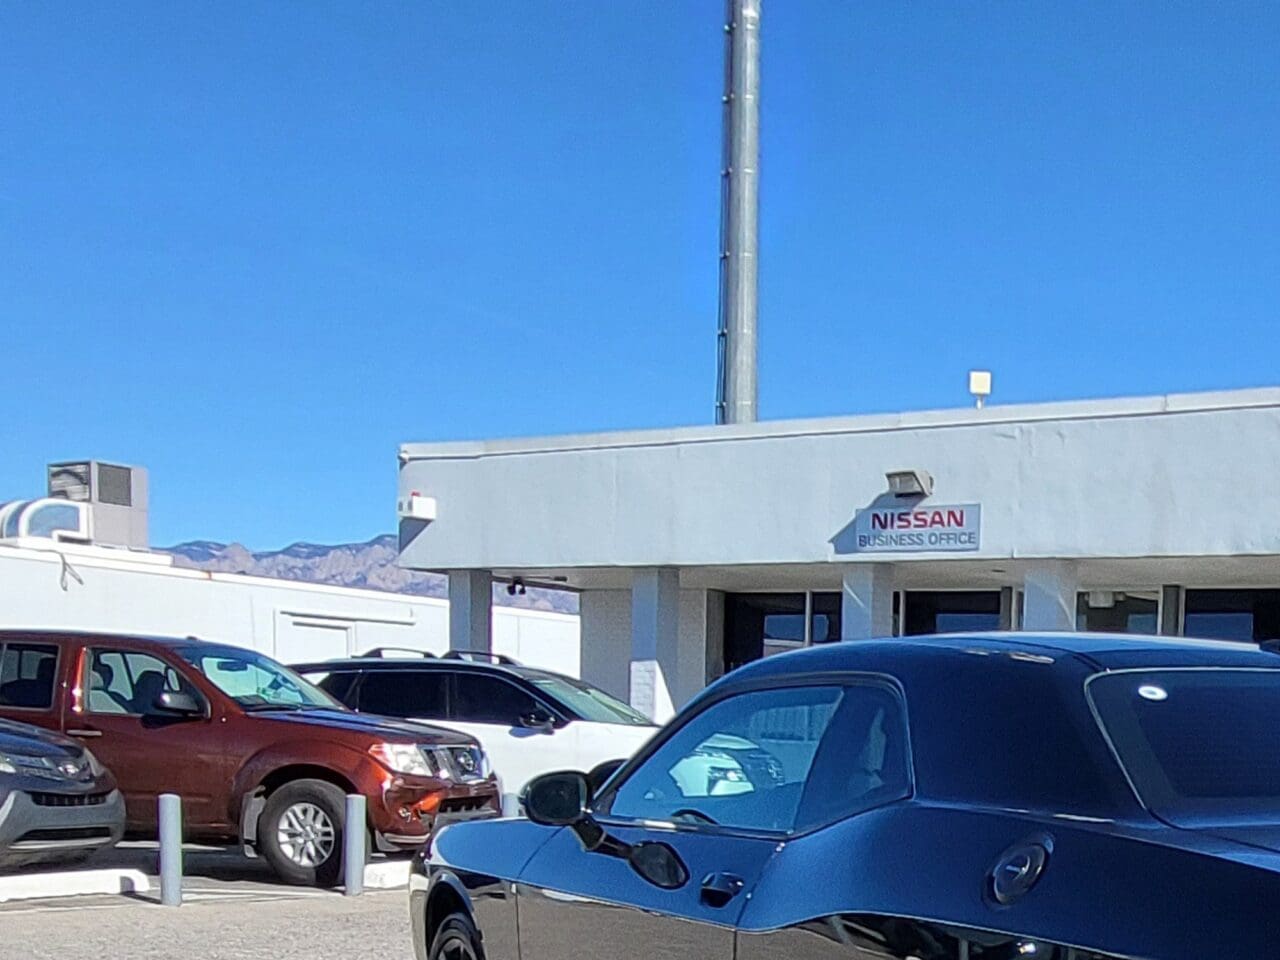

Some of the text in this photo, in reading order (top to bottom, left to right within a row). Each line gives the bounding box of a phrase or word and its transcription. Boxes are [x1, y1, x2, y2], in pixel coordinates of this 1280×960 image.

[872, 510, 964, 530] NISSAN
[858, 532, 976, 548] BUSINESS OFFICE
